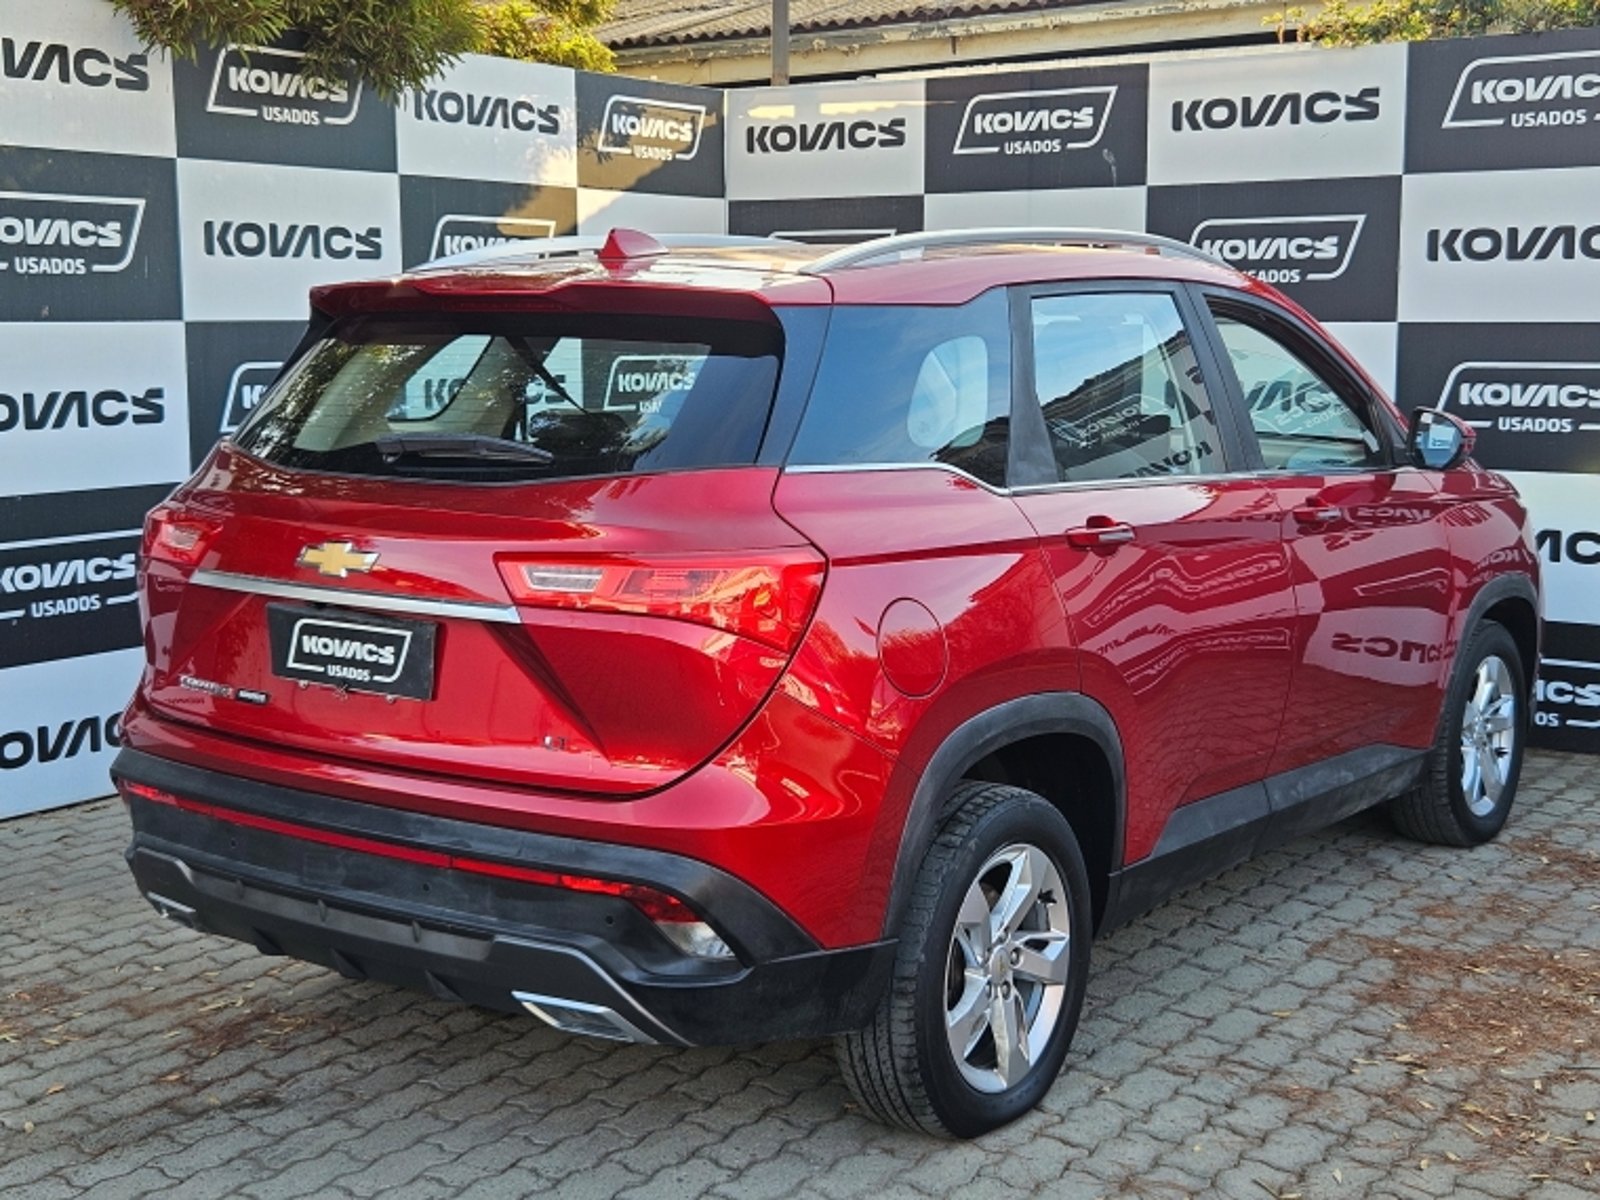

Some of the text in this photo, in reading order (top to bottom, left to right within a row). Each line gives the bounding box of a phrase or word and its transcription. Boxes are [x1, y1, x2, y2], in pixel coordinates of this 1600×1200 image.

[229, 66, 348, 102] KOVACS
[1471, 73, 1600, 104] KOVAC
[262, 105, 320, 125] USADOS
[413, 89, 560, 135] KOVACS
[974, 106, 1094, 135] KOVACS
[1171, 86, 1380, 131] KOVACS
[1510, 109, 1588, 127] USADOS
[612, 113, 693, 142] KOVACS
[746, 118, 906, 154] KOVACS
[633, 145, 673, 161] USADOS
[1004, 138, 1061, 155] USADOS
[0, 216, 121, 247] OVACS
[203, 220, 383, 260] KOVACS
[15, 256, 87, 275] USADOS
[617, 371, 696, 393] KOVACS
[1498, 415, 1574, 433] USADOS
[30, 594, 101, 618] USADOS
[301, 634, 396, 666] KOVACS
[327, 664, 371, 682] USADOS
